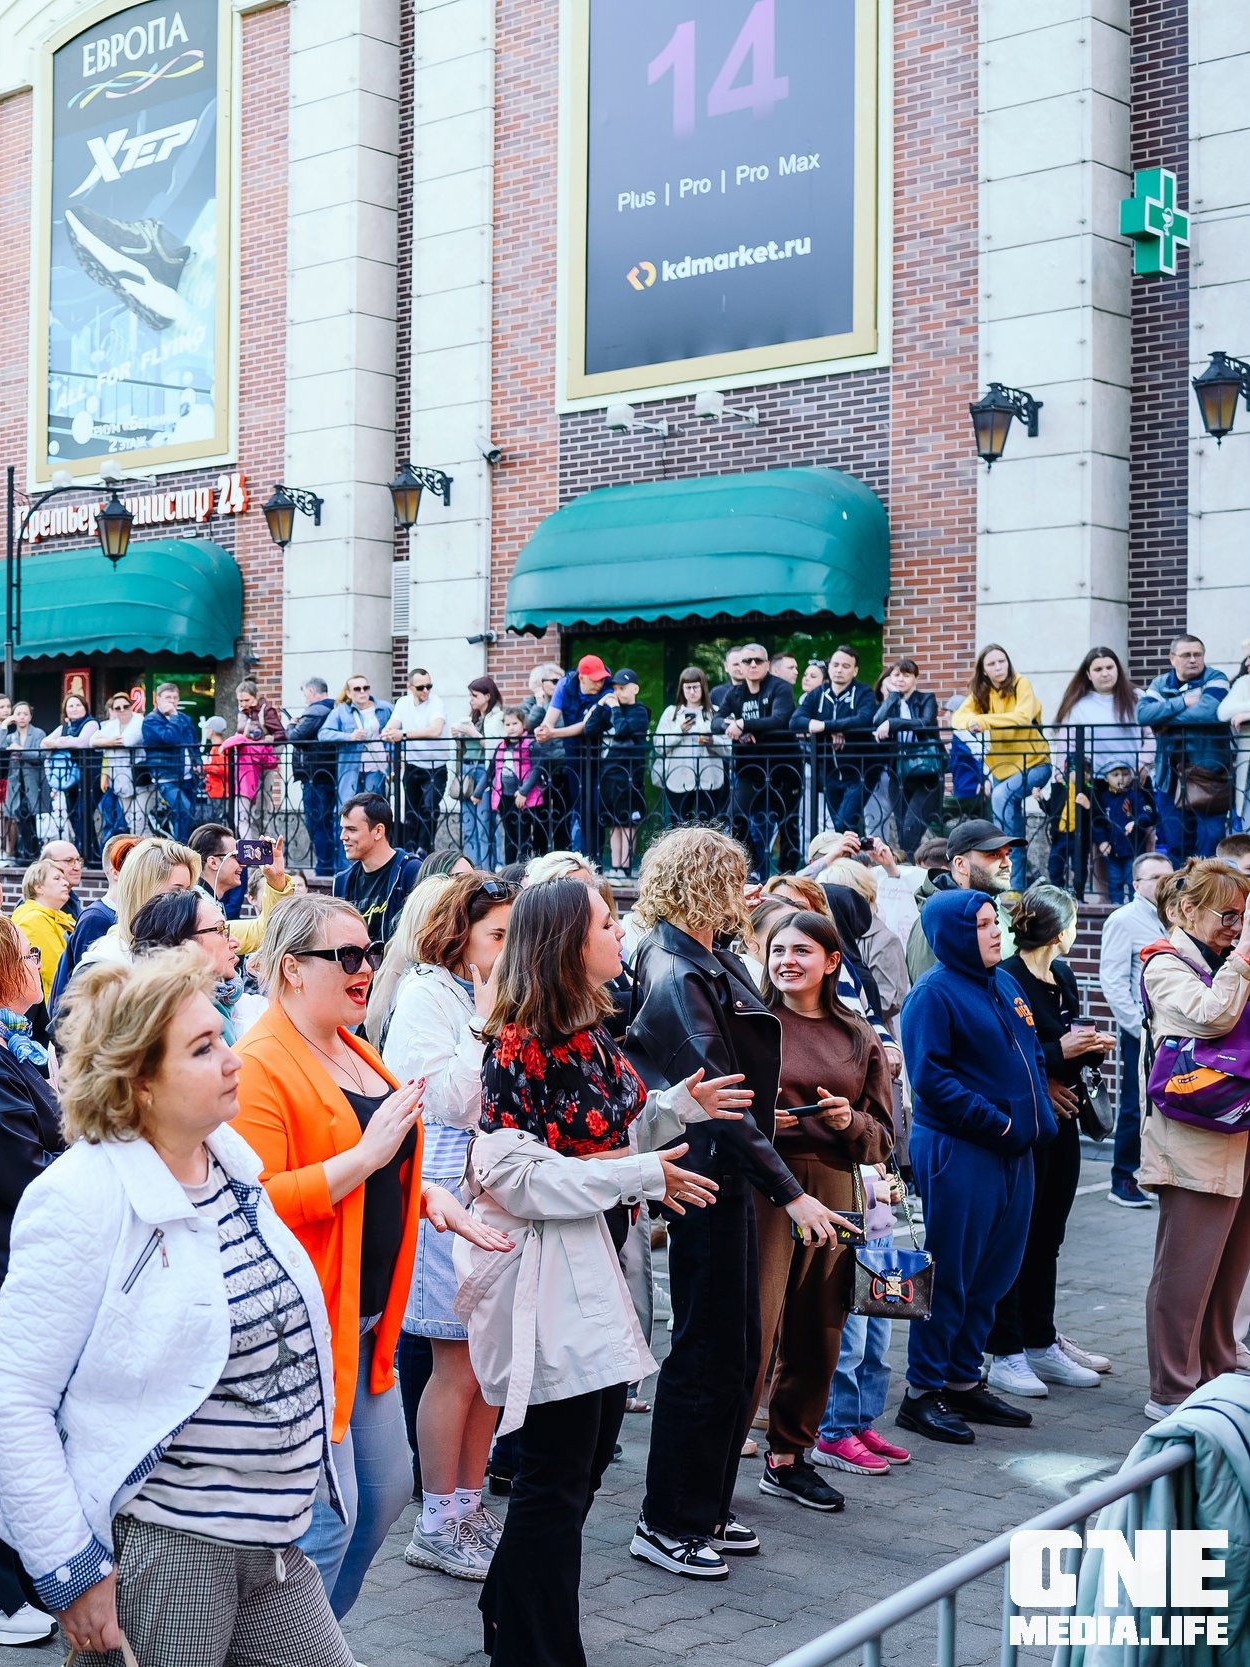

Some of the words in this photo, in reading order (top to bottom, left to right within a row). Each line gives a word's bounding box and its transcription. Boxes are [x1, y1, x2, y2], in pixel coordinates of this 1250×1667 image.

[82, 11, 189, 78] ЕВРОПА
[647, 0, 789, 141] 14
[68, 118, 198, 198] XTEP
[618, 190, 656, 212] Plus
[679, 177, 712, 199] Pro
[736, 164, 769, 186] Pro
[778, 152, 821, 177] Max
[662, 236, 811, 282] kdmarket.ru
[55, 381, 86, 413] ALL
[97, 362, 131, 392] FOR
[217, 473, 248, 514] 24
